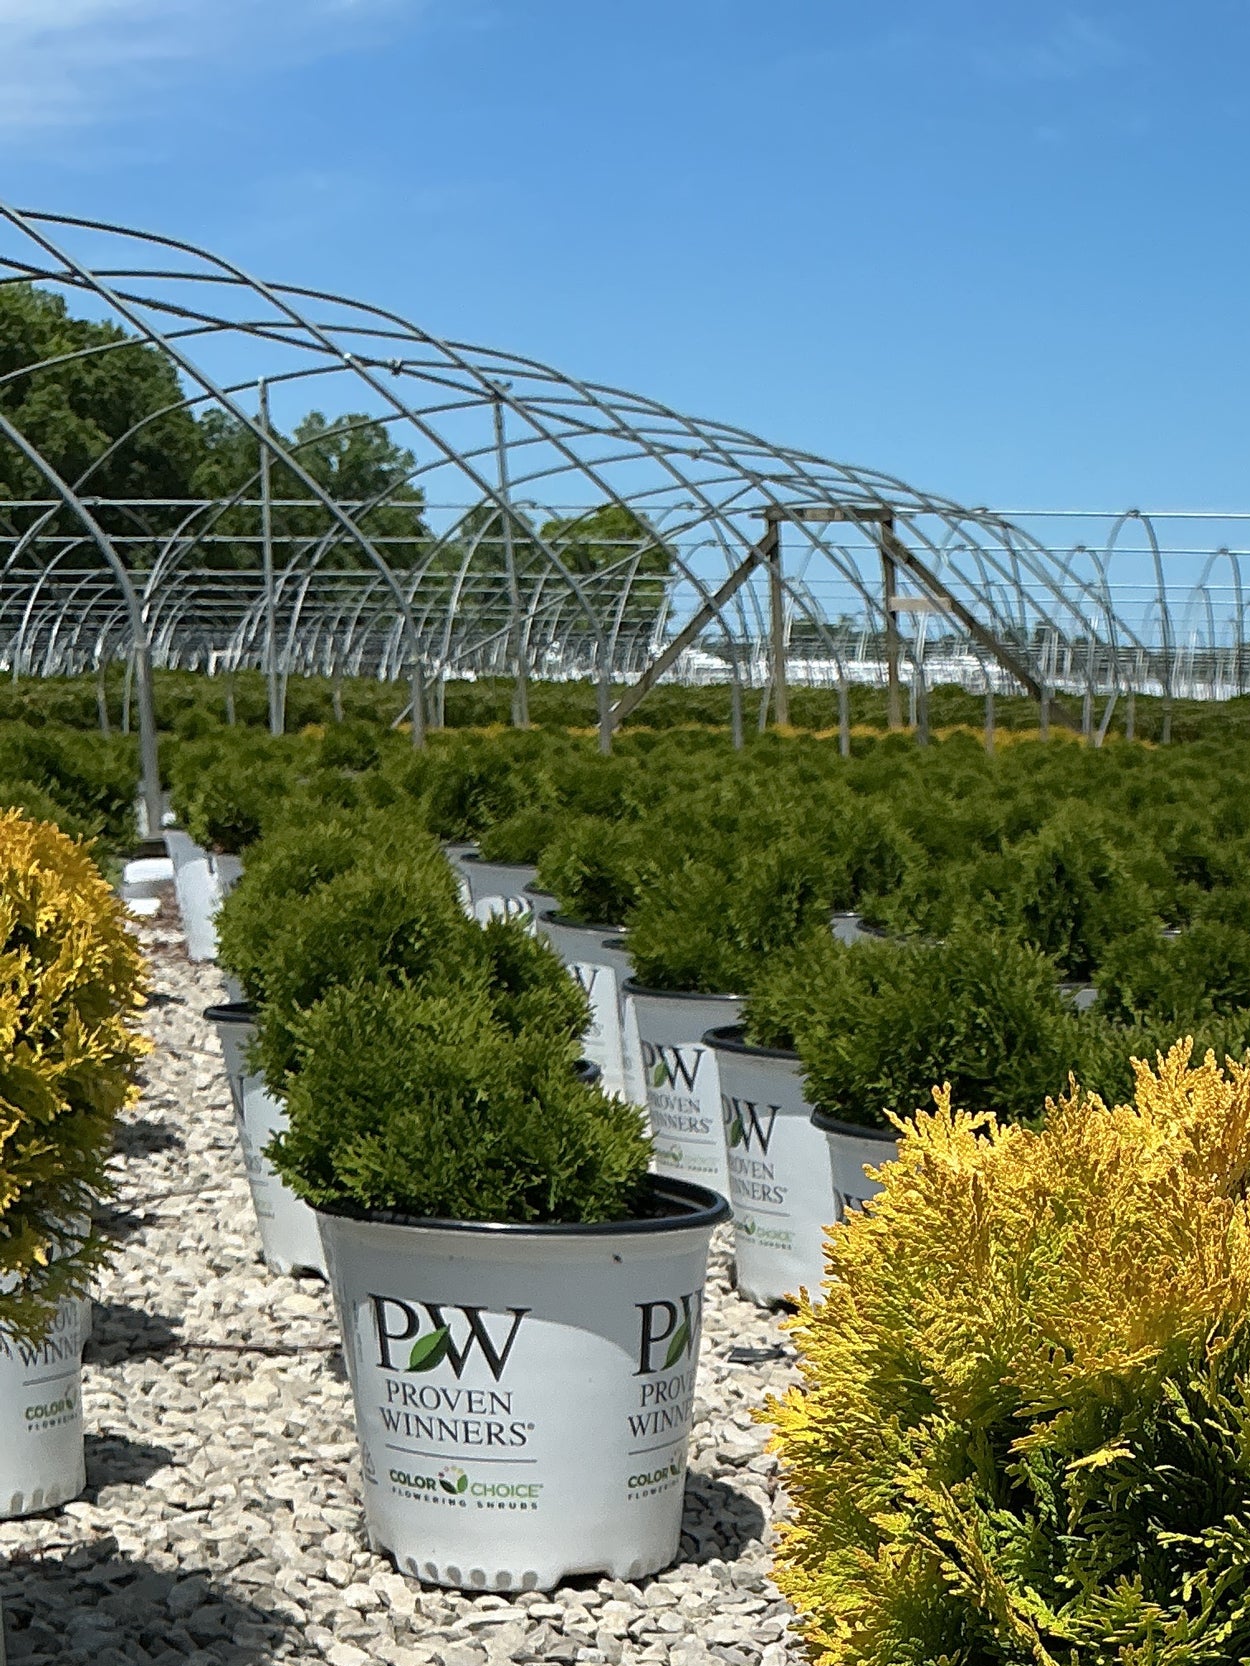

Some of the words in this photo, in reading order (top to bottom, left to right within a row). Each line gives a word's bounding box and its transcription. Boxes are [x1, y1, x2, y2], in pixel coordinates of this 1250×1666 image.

[367, 1292, 532, 1383] PW
[385, 1378, 514, 1416] PROVEN
[390, 1468, 437, 1491] COLOR
[470, 1482, 541, 1499] CHOICE
